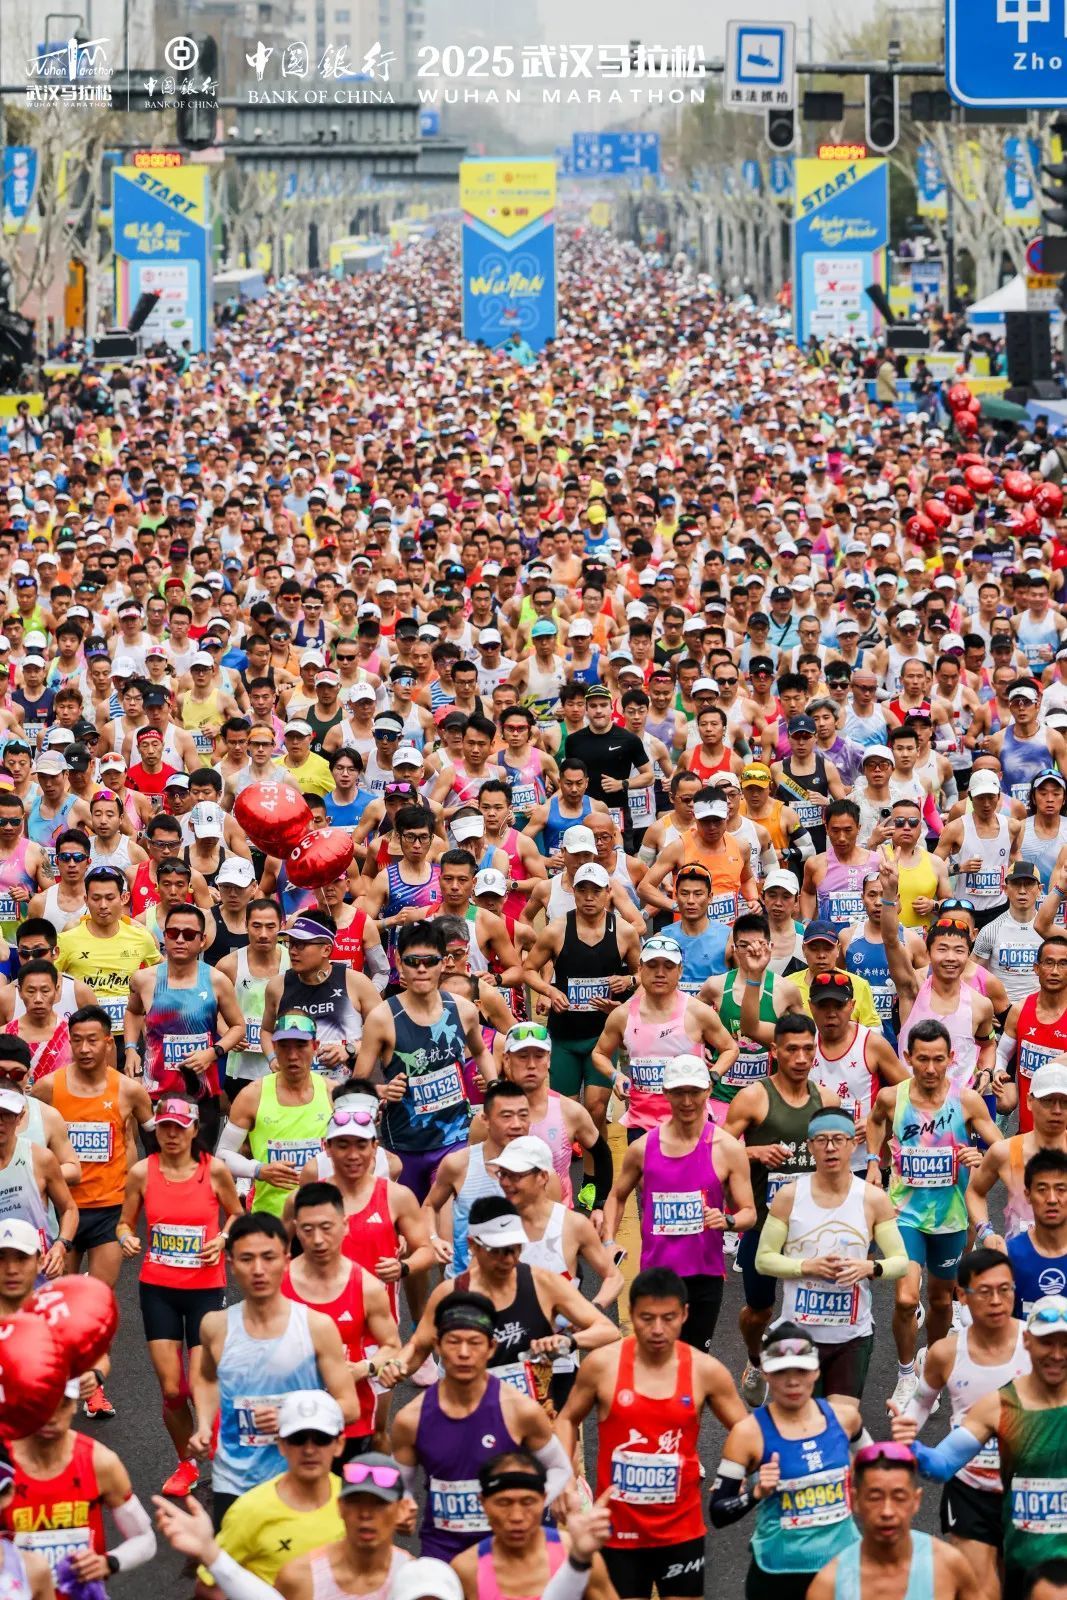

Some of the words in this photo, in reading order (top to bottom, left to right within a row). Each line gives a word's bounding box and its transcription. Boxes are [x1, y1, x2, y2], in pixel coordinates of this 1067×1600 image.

[731, 89, 789, 105] 违法抓拍
[134, 171, 198, 213] START
[801, 165, 857, 212] START
